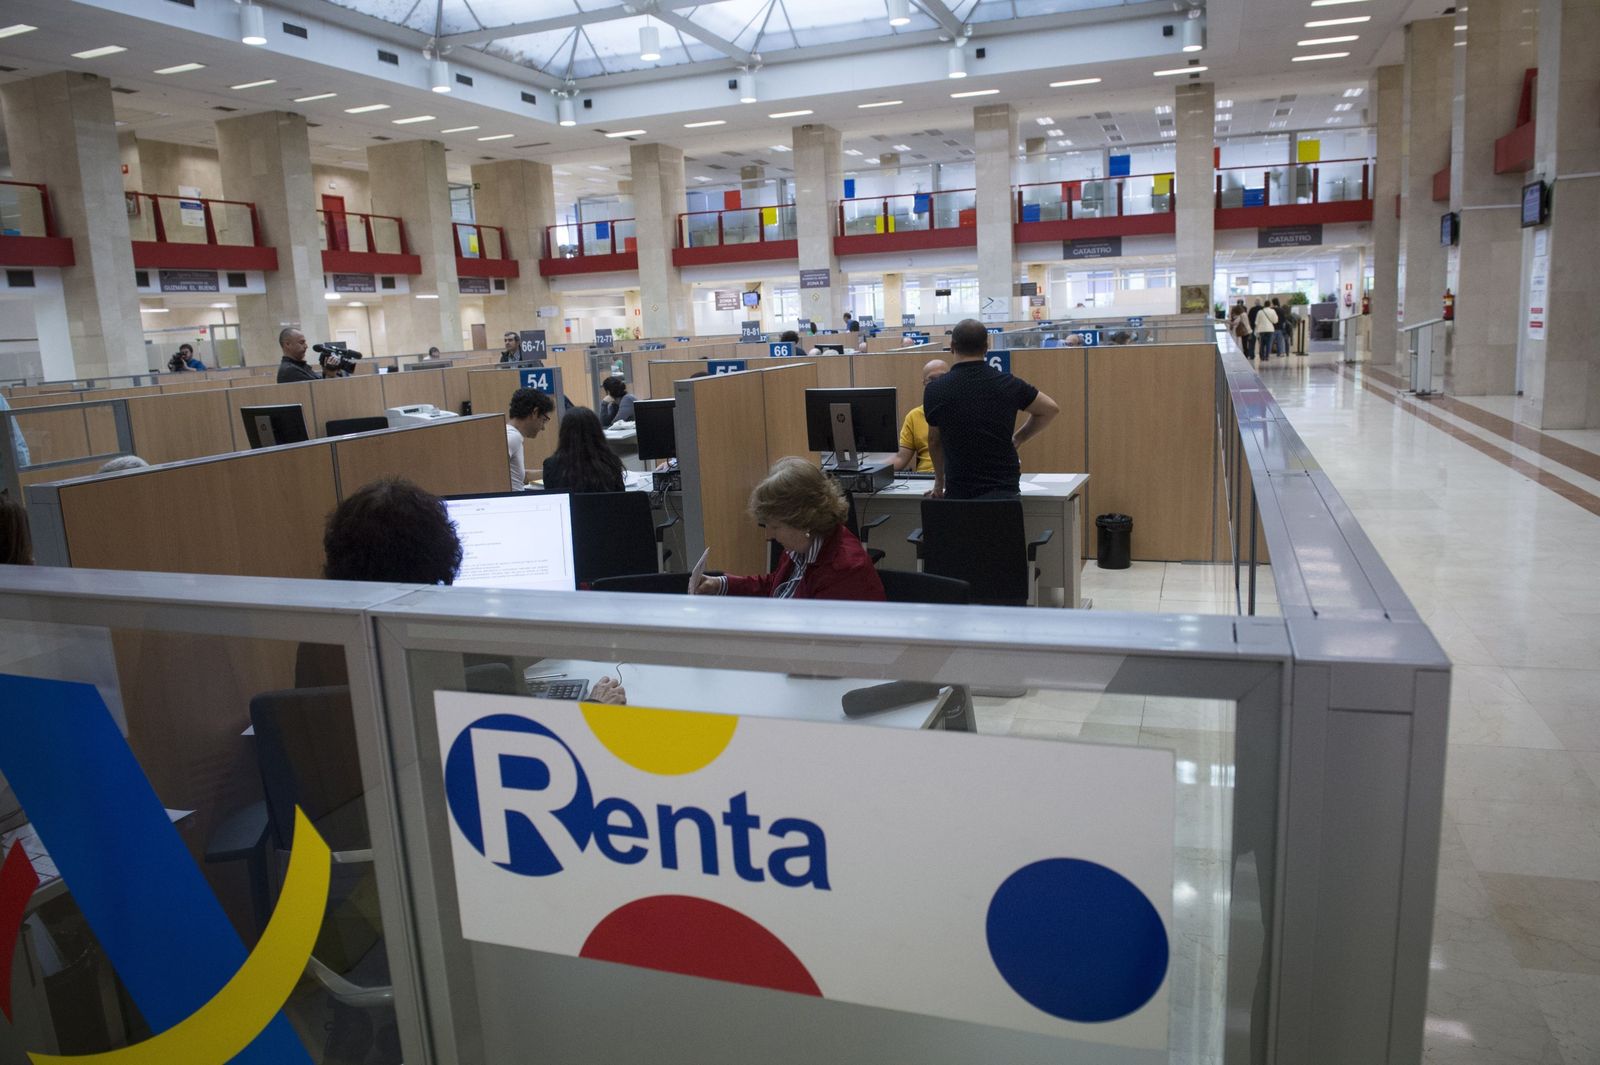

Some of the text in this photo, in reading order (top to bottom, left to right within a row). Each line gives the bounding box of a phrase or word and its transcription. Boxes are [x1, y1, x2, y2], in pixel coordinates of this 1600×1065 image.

[1268, 234, 1312, 244] CATASTRO
[1072, 246, 1112, 256] CATASTRO
[743, 327, 760, 336] 78-81
[596, 334, 613, 344] 72-77
[521, 339, 546, 352] 66-71
[774, 345, 788, 356] 66
[527, 372, 549, 391] 54
[470, 726, 832, 891] Renta
